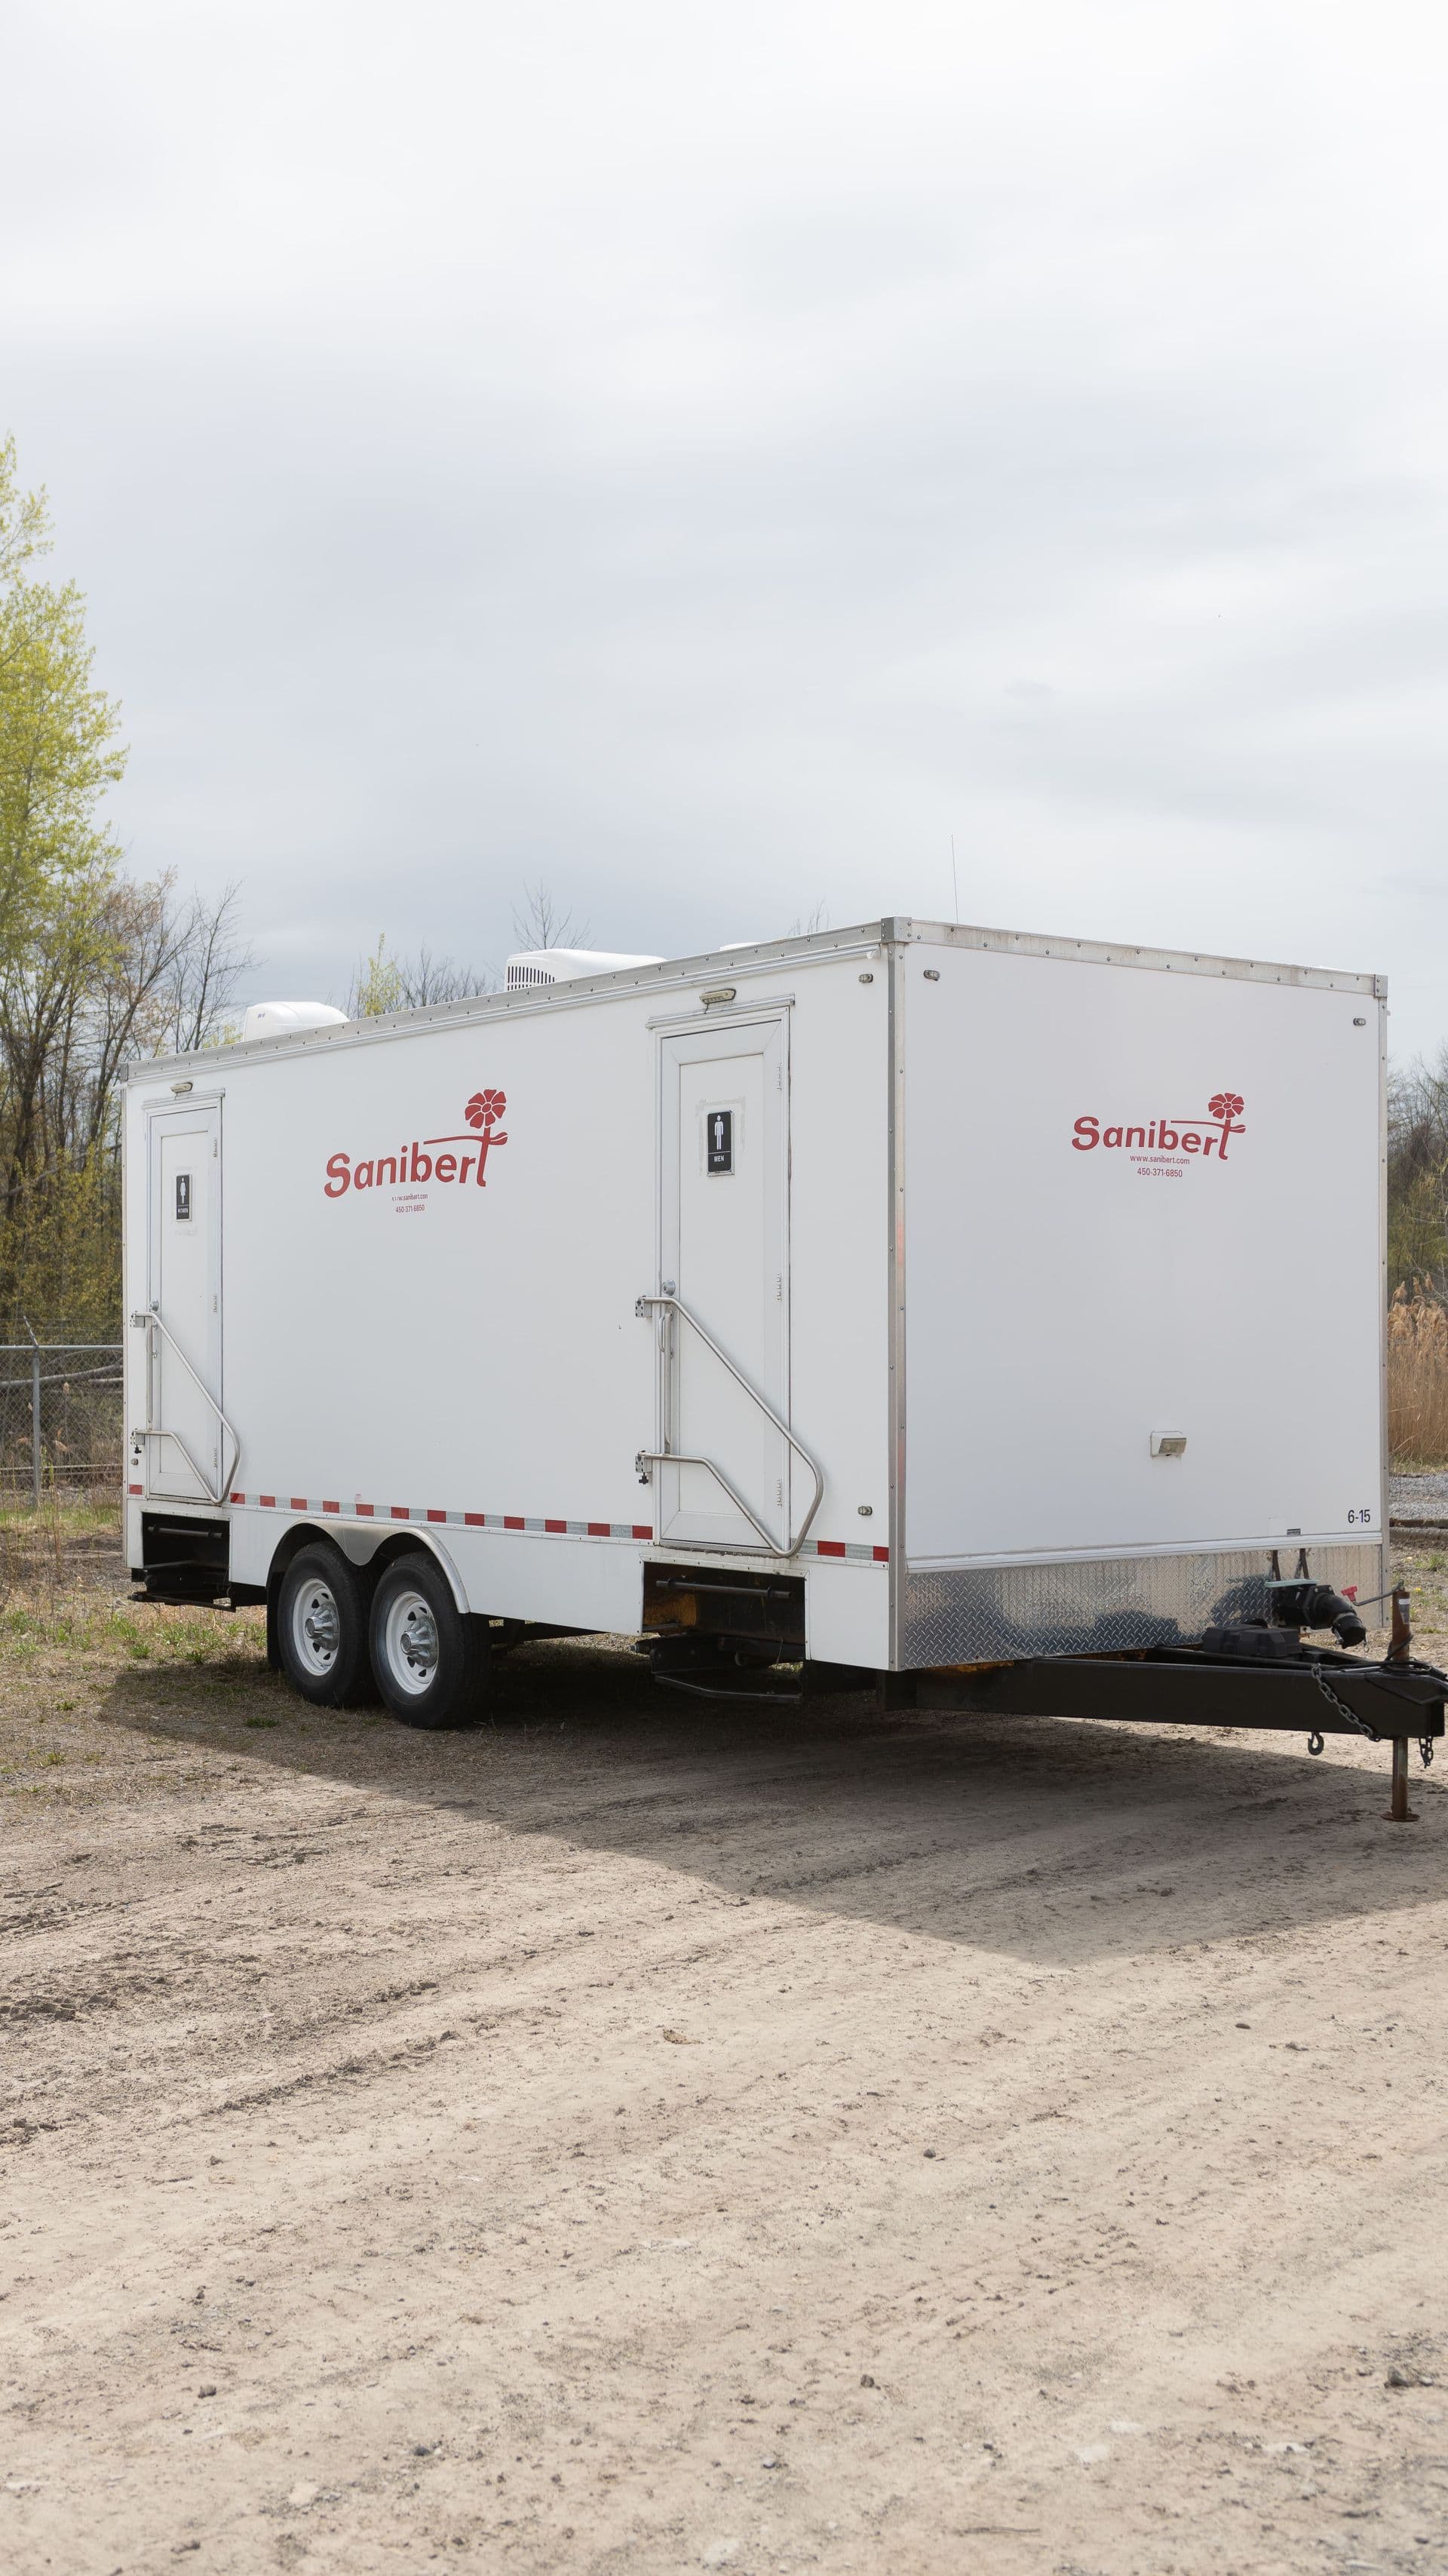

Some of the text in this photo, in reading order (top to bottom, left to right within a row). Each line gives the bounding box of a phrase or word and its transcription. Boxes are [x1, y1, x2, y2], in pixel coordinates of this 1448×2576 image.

[1072, 1117, 1246, 1161] Sanibert
[324, 1127, 508, 1198] Sanibert
[1130, 1155, 1190, 1164] www.sanibert.com
[1137, 1167, 1183, 1177] 450-371-6850
[1348, 1510, 1370, 1523] 6-15
